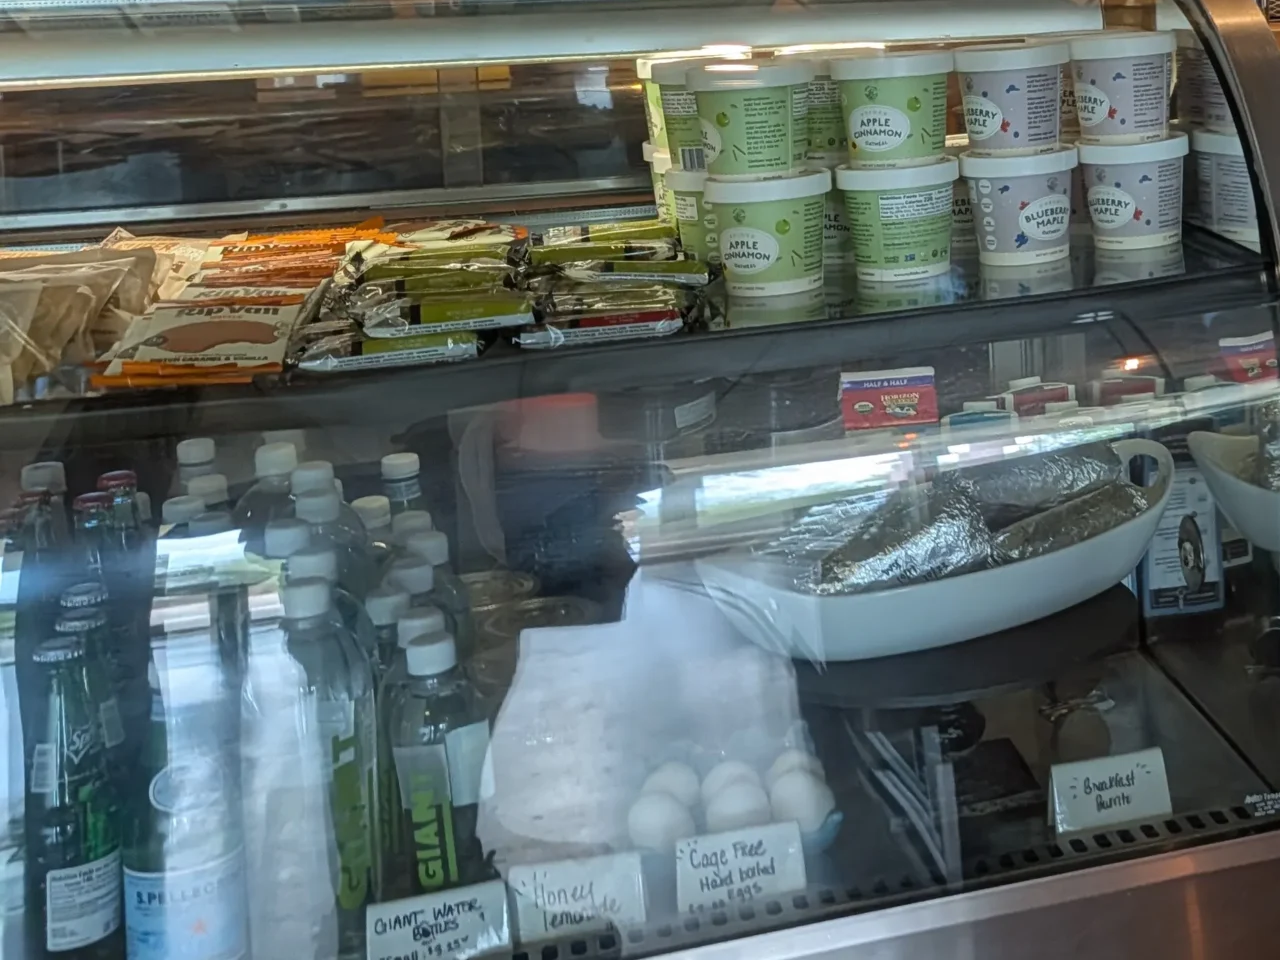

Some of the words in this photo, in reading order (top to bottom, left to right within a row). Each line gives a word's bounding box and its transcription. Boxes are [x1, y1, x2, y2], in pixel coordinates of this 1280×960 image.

[860, 118, 890, 128] APPLE
[854, 128, 902, 139] CINNAMON
[1024, 204, 1070, 224] BLUEBERRY
[1036, 216, 1065, 229] MAPLE
[729, 240, 758, 251] APPLE
[724, 250, 771, 261] CINNAMON
[690, 849, 728, 873] Cage
[374, 910, 424, 935] GIANT
[433, 899, 481, 921] WATER
